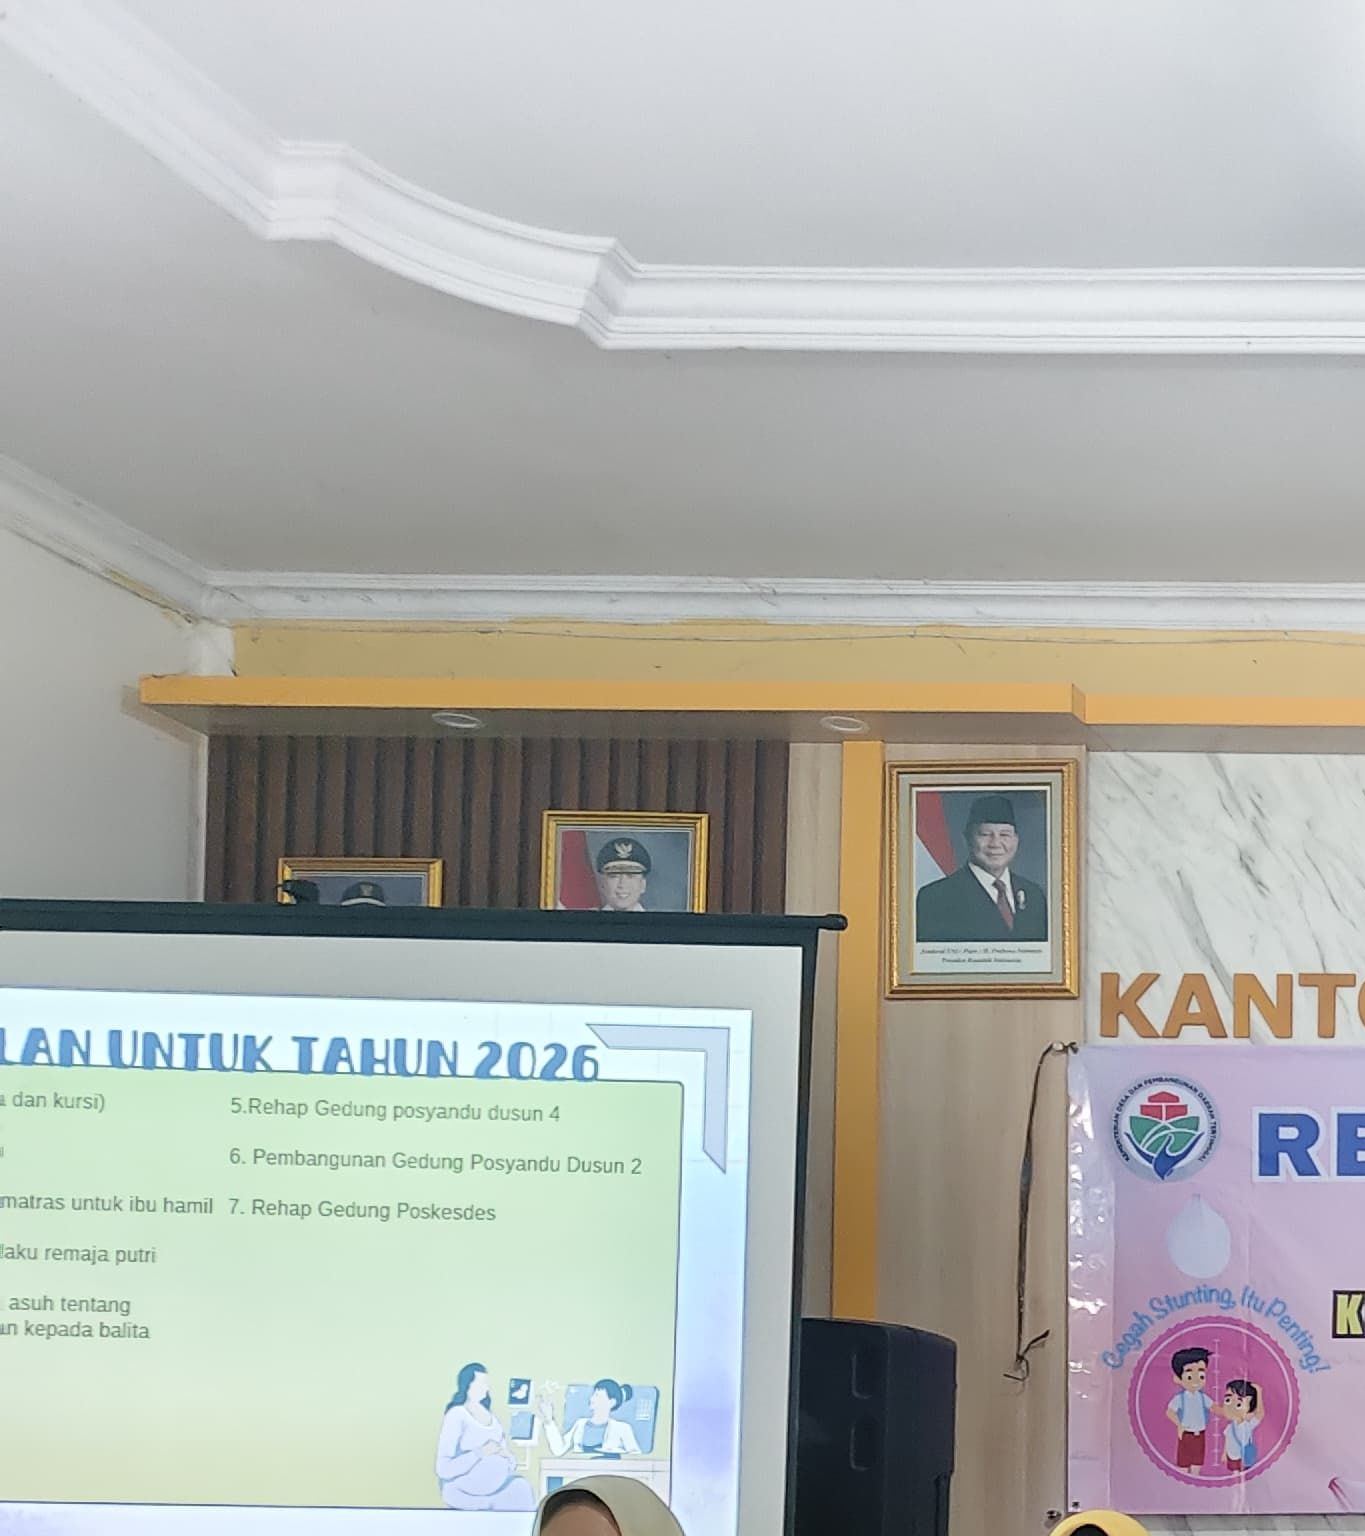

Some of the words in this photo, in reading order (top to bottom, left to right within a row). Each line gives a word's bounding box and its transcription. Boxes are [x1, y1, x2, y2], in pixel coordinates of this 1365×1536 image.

[108, 1030, 273, 1073] UNTUK
[291, 1036, 459, 1078] TAHUN
[474, 1041, 600, 1082] 2026
[12, 1091, 47, 1108] dan
[53, 1091, 105, 1113] kursi)
[230, 1097, 308, 1118] 5.Rehap
[315, 1099, 387, 1121] Gedung
[392, 1103, 482, 1123] posyandu
[487, 1105, 543, 1122] dusun
[549, 1106, 561, 1123] 4
[229, 1148, 247, 1165] 6.
[252, 1148, 386, 1171] Pembangunan
[392, 1151, 464, 1173] Gedung
[470, 1154, 561, 1175] Posyandu
[567, 1157, 625, 1174] Dusun
[631, 1158, 643, 1175] 2
[71, 1196, 123, 1212] untuk
[129, 1196, 157, 1213] ibu
[163, 1197, 214, 1214] hamil
[227, 1198, 245, 1216] 7.
[251, 1199, 313, 1220] Rehap
[318, 1201, 391, 1222] Gedung
[396, 1202, 497, 1222] Poskesdes
[45, 1246, 110, 1266] remaja
[115, 1247, 157, 1266] putri
[8, 1295, 54, 1311] asuh
[60, 1297, 131, 1317] tentang
[24, 1319, 94, 1340] kepada
[99, 1321, 151, 1339] balita
[1102, 1311, 1155, 1370] Cegah
[1241, 1285, 1267, 1313] Itu
[1264, 1298, 1332, 1374] Penting!
